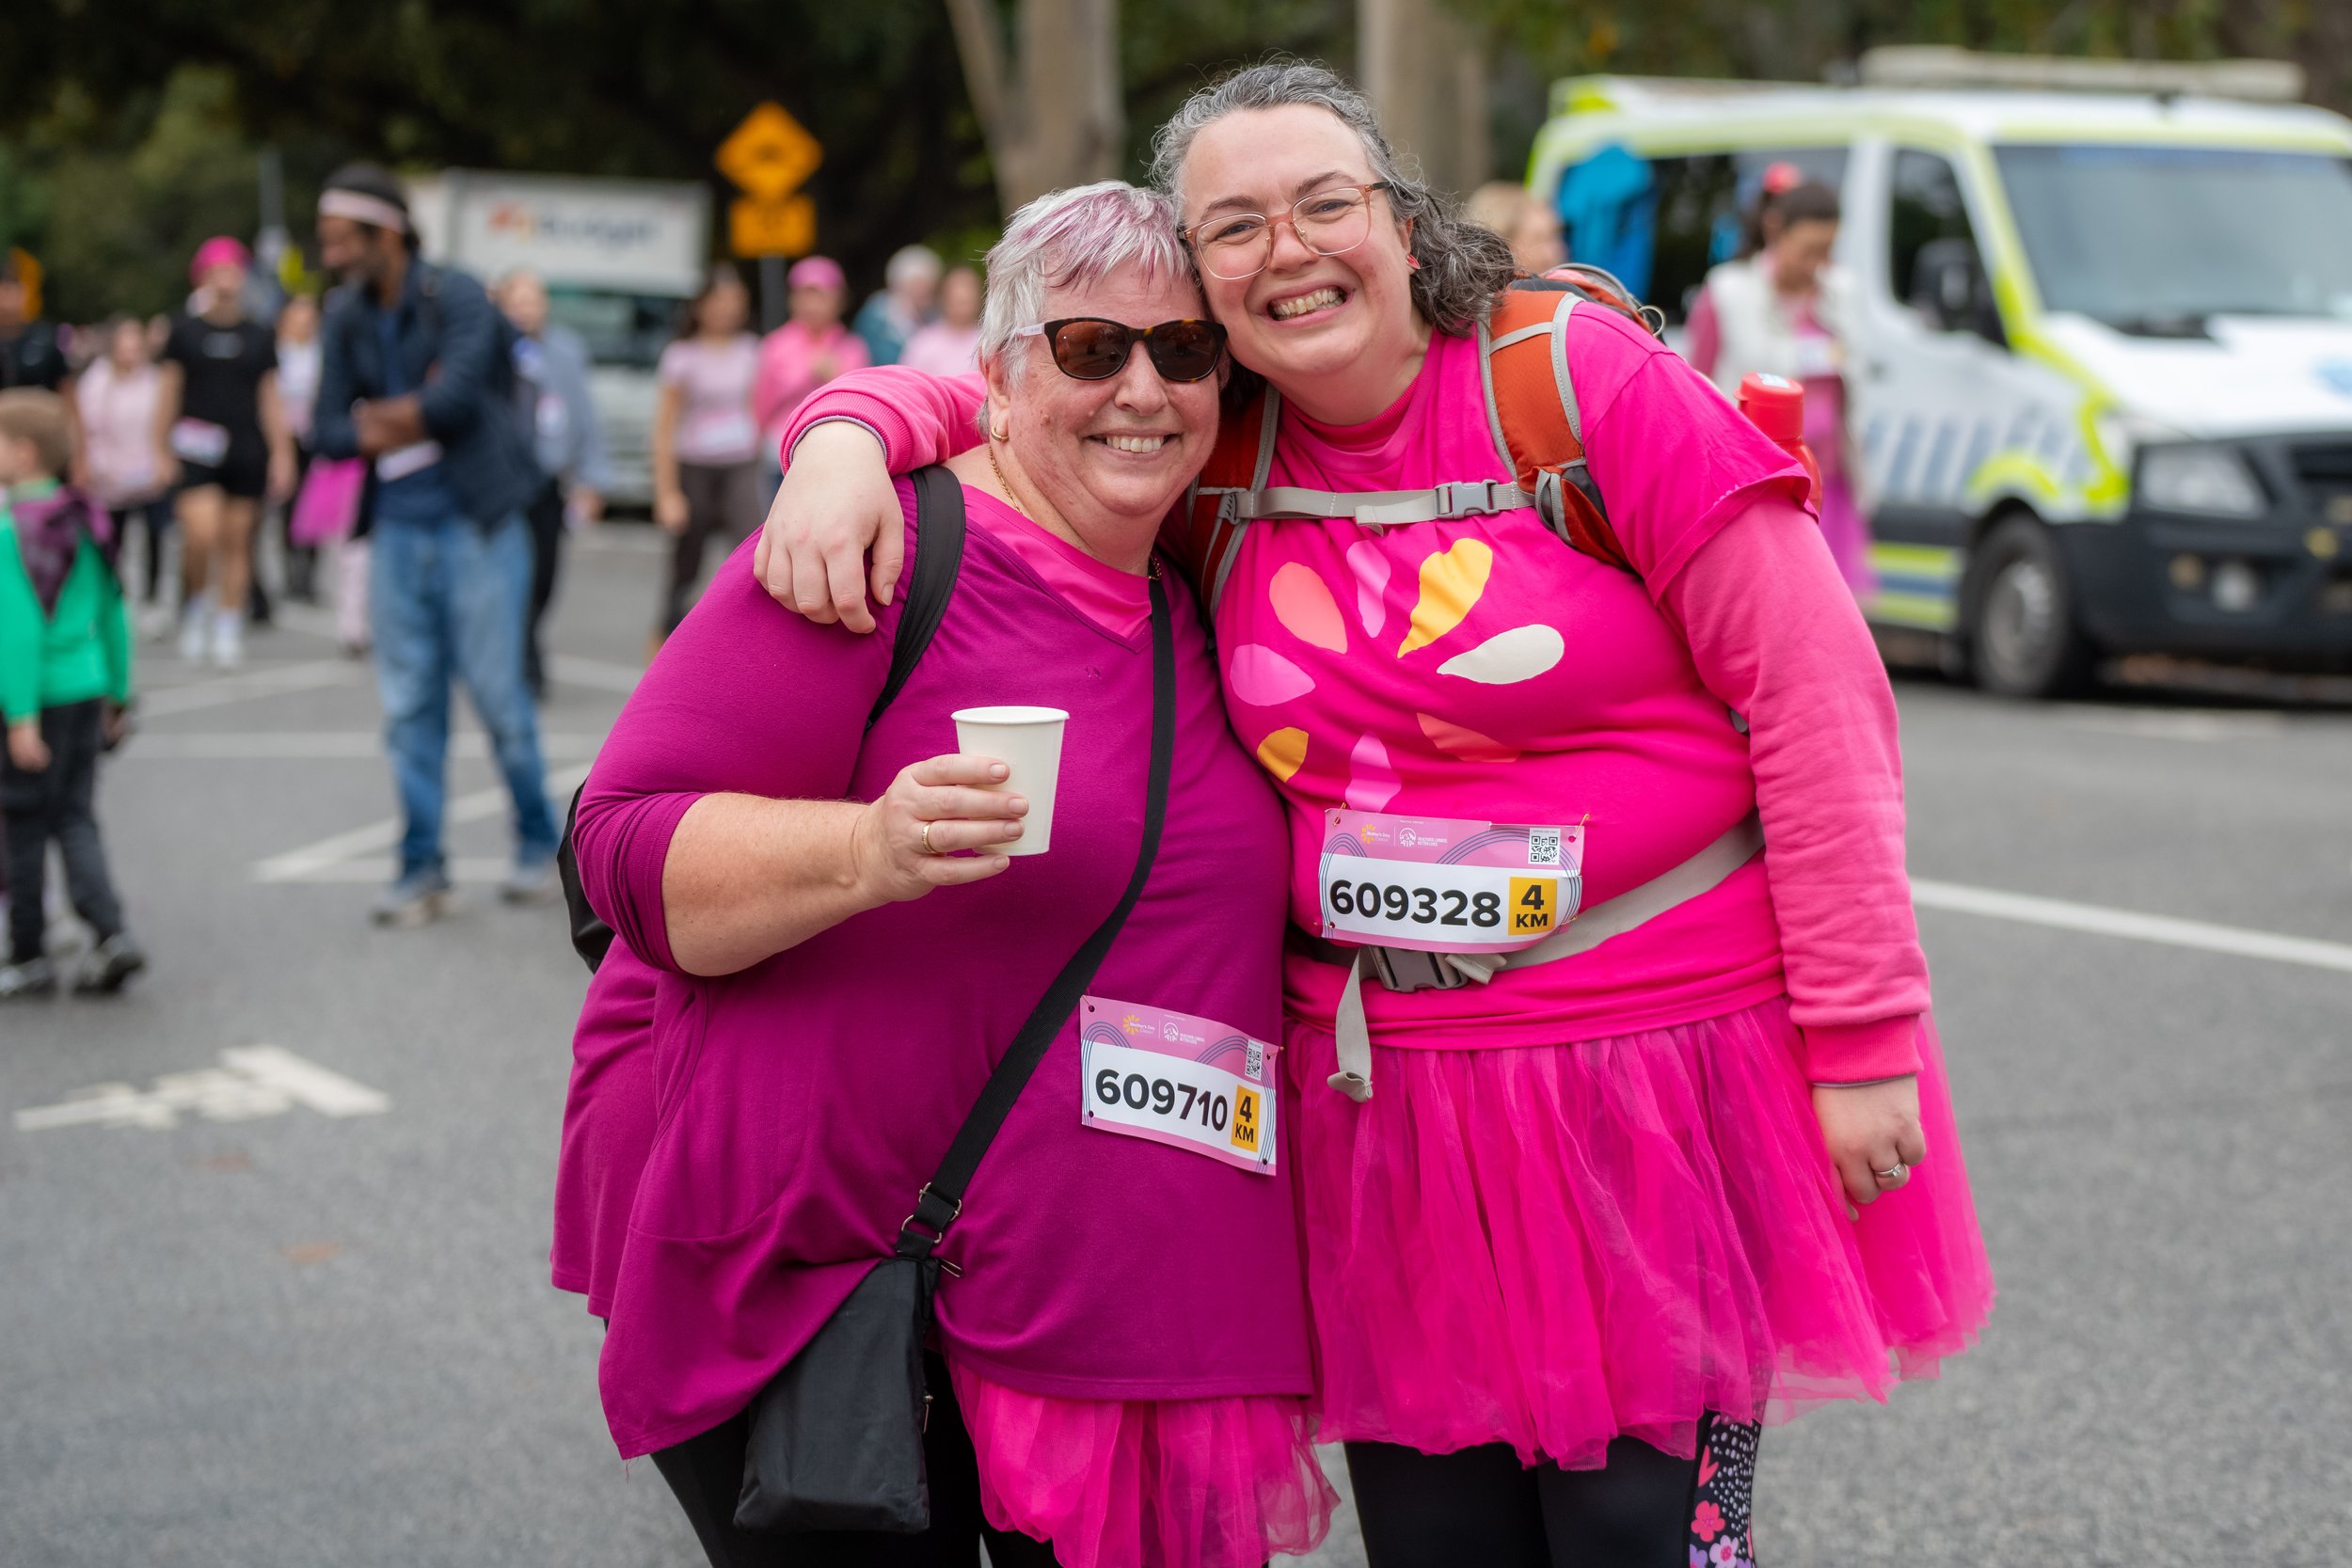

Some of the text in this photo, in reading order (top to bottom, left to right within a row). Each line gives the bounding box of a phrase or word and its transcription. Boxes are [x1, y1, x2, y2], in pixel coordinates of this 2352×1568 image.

[1329, 879, 1502, 928] 609328
[1520, 884, 1545, 911] 4
[1516, 913, 1549, 928] KM
[1095, 1069, 1228, 1132] 609710
[1239, 1095, 1252, 1123] 4
[1234, 1122, 1254, 1144] KM
